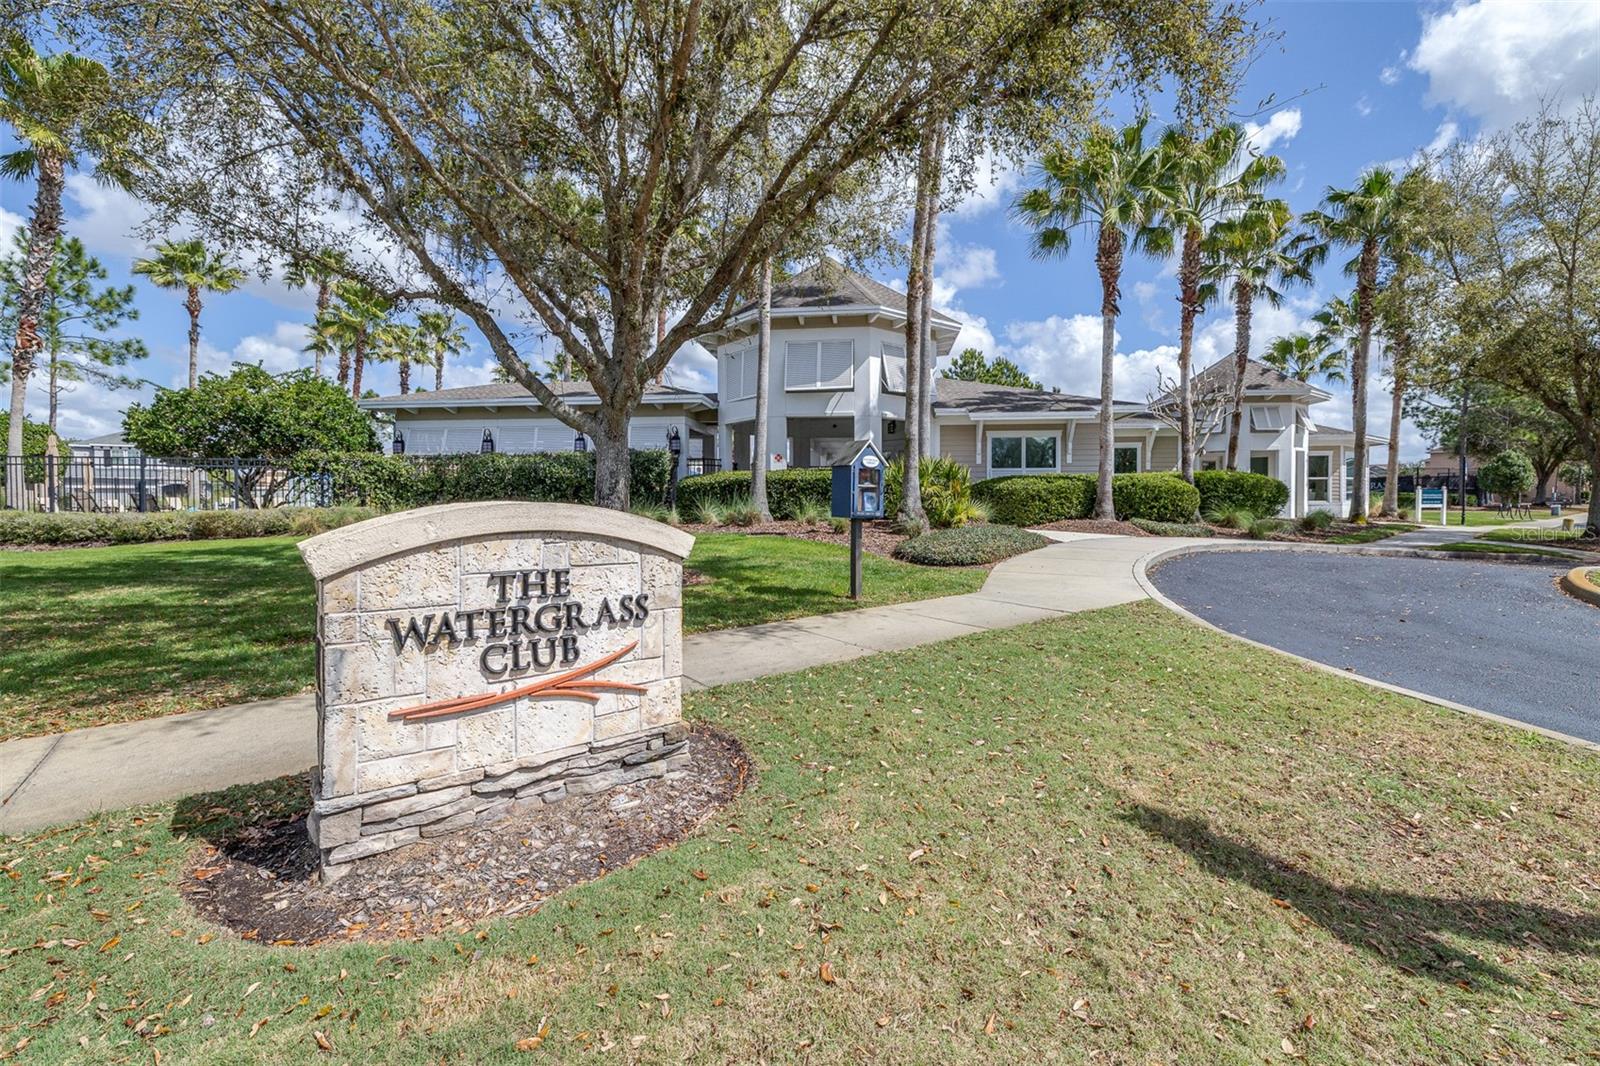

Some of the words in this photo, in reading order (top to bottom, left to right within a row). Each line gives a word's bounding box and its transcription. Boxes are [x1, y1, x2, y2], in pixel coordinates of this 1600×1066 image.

[490, 568, 571, 603] THE
[386, 593, 649, 649] WATERGRASS
[480, 634, 581, 674] CLUB
